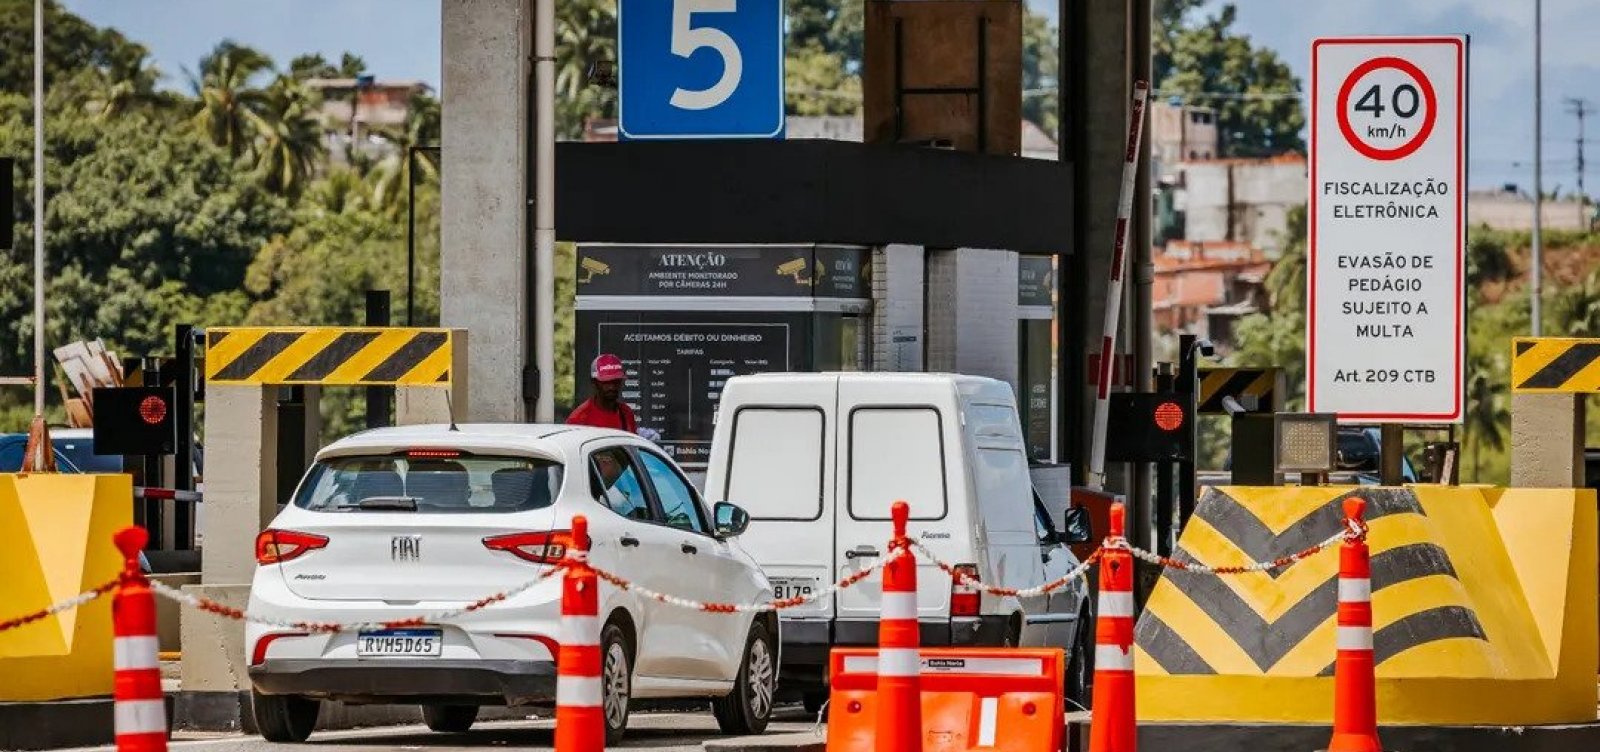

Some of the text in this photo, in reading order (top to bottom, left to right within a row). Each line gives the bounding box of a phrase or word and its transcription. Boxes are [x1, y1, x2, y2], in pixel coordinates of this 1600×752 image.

[669, 0, 742, 110] 5
[1354, 83, 1421, 119] 40
[1367, 123, 1407, 139] km/h
[1324, 178, 1448, 198] FISCALIZAÇÃO
[1333, 202, 1439, 219] ELETRÔNICA
[658, 251, 726, 270] ATENÇÃO
[1338, 252, 1433, 269] EVASÃO DE
[649, 271, 739, 280] AMBIENTE MONITORADO
[1348, 275, 1422, 292] PEDÁGIO
[658, 279, 727, 289] POR CÂMERAS 24H
[1342, 301, 1428, 315] SUJEITO A
[623, 333, 762, 342] ACEITAMOS DÉBITO OU DINHEIRO
[1356, 324, 1414, 338] MULTA
[1333, 369, 1436, 383] Art. 209 CTB
[391, 536, 422, 560] FIAT
[365, 637, 433, 653] RVH5D65
